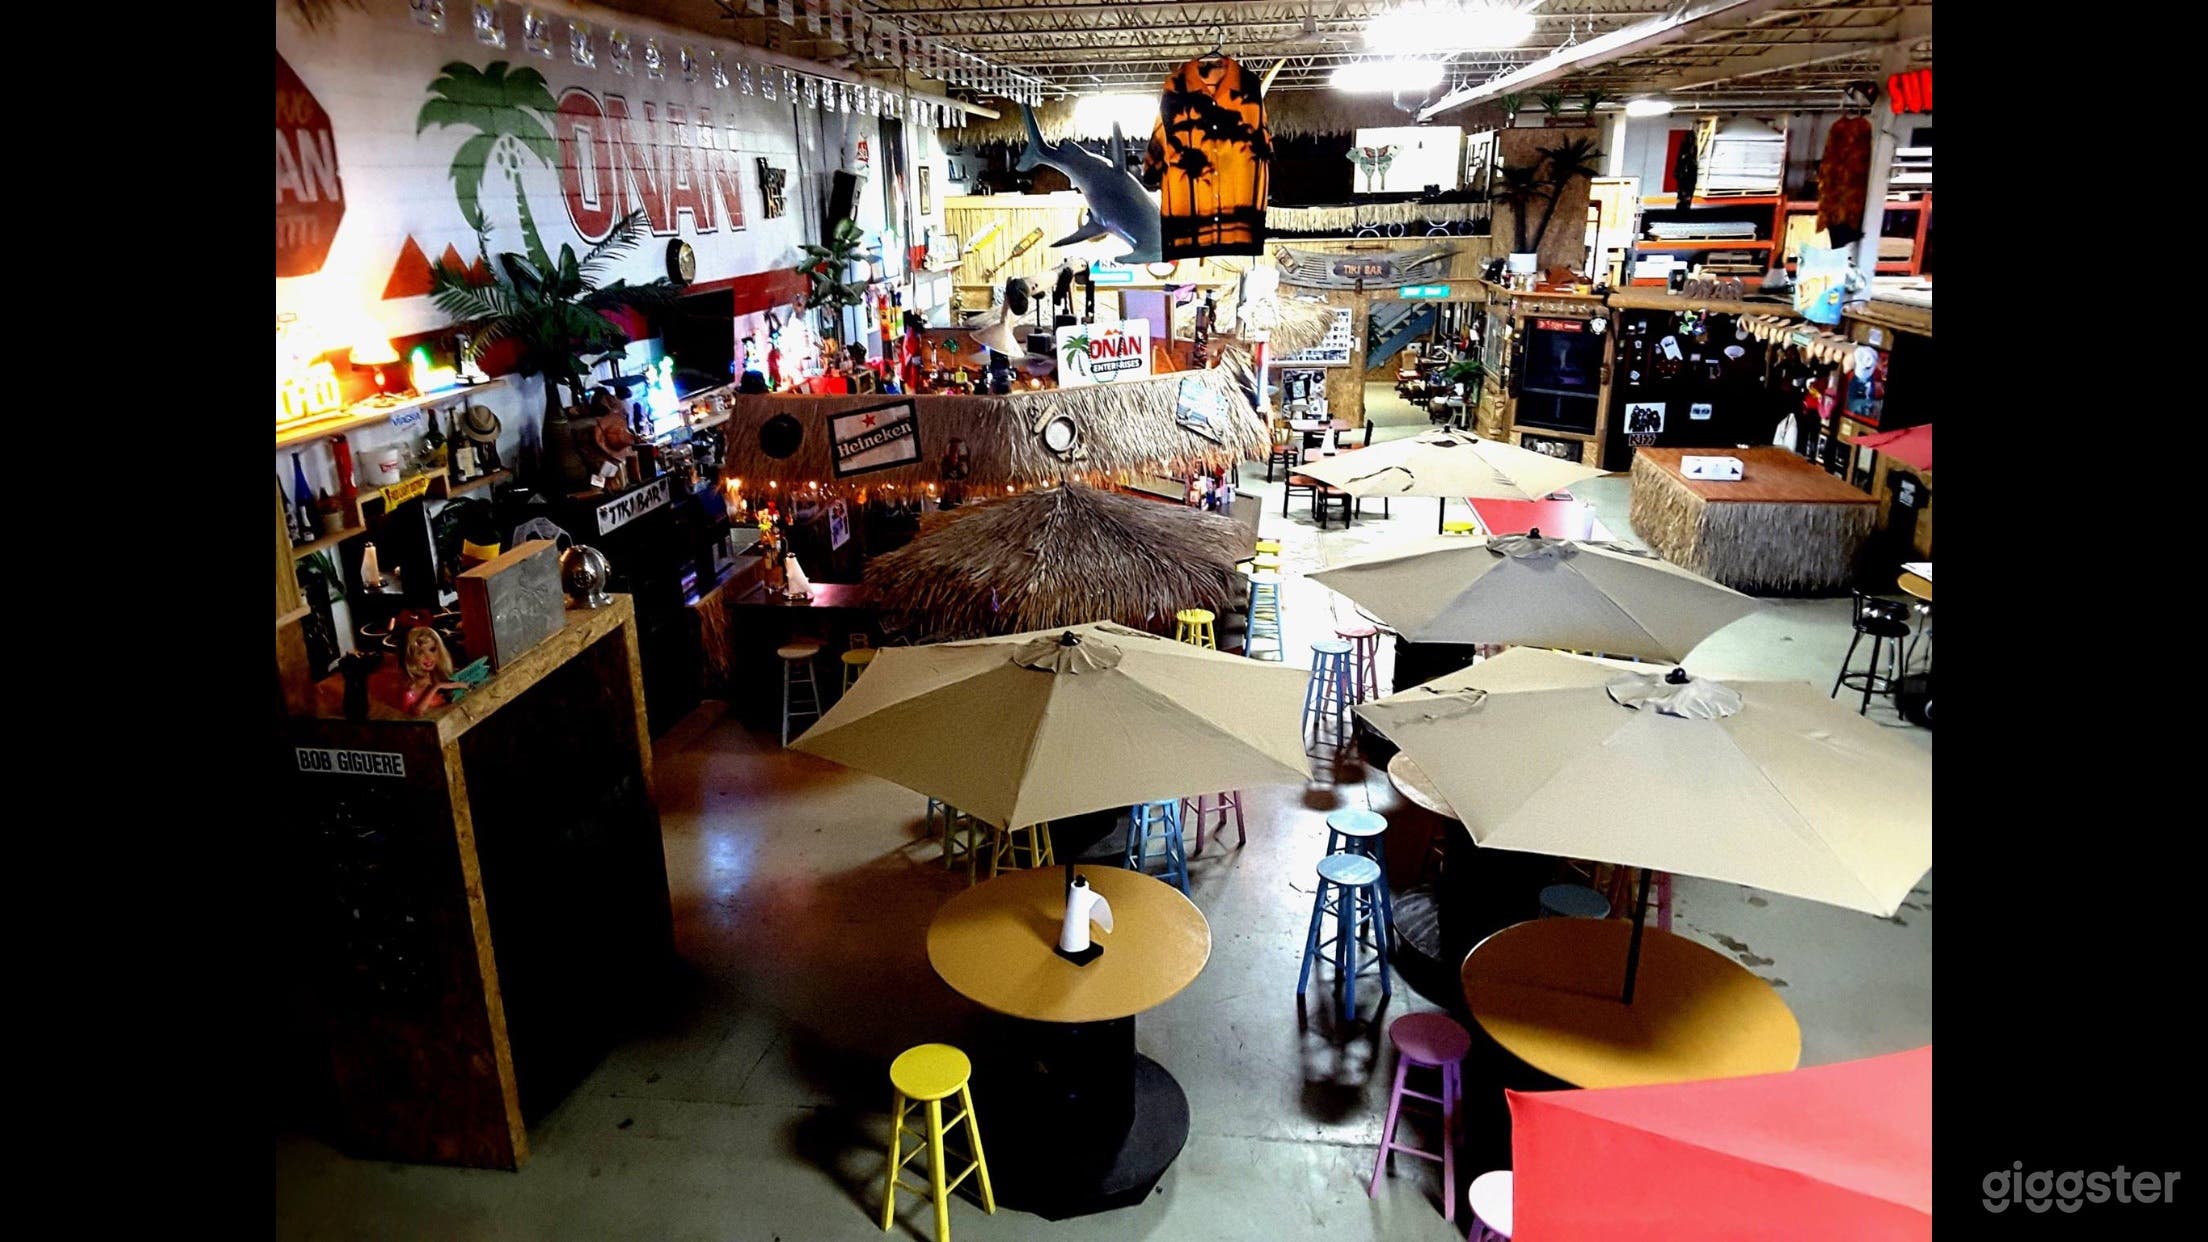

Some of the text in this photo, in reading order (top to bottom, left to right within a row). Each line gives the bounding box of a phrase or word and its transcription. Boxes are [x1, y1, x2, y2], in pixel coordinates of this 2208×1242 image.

[1343, 264, 1383, 275] TIKI BAR
[837, 422, 912, 458] Heineken
[609, 485, 661, 525] TIKI BAR
[299, 750, 403, 775] BOB GIGUERE
